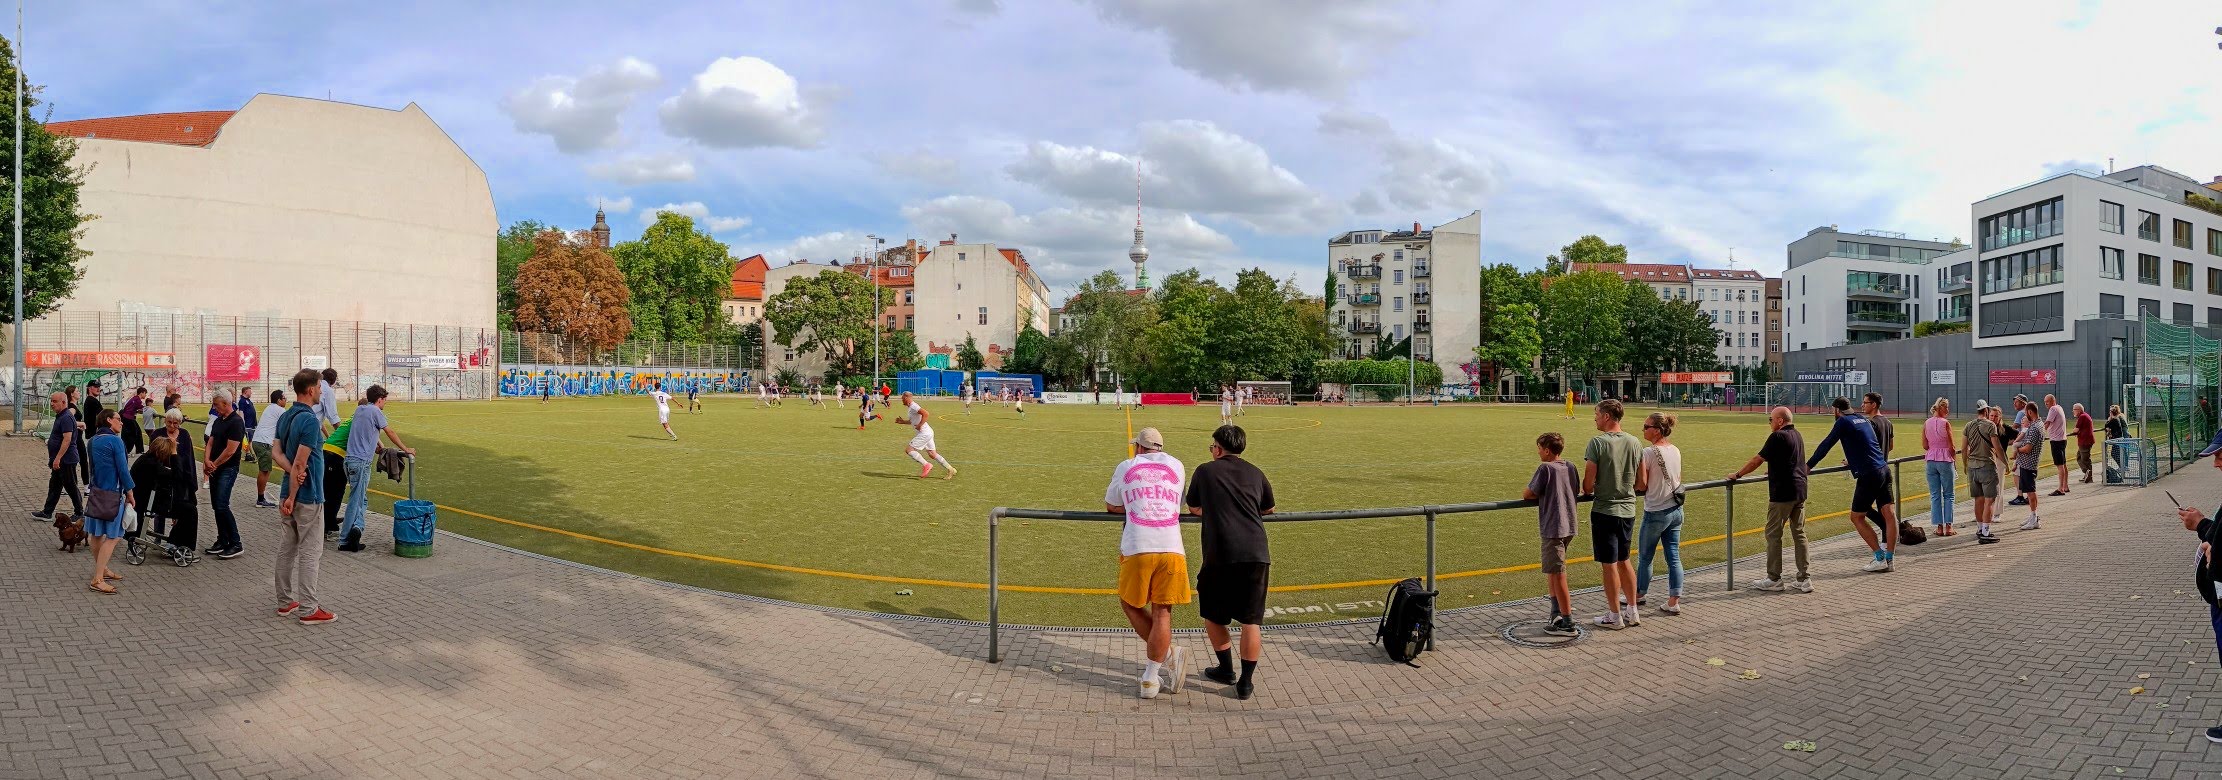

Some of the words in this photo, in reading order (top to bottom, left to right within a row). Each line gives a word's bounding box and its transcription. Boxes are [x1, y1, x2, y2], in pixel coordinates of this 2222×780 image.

[41, 353, 61, 365] KEIN
[61, 353, 89, 366] PLATZ
[97, 353, 145, 366] RASSISMUS
[514, 374, 633, 396] BEROLINA
